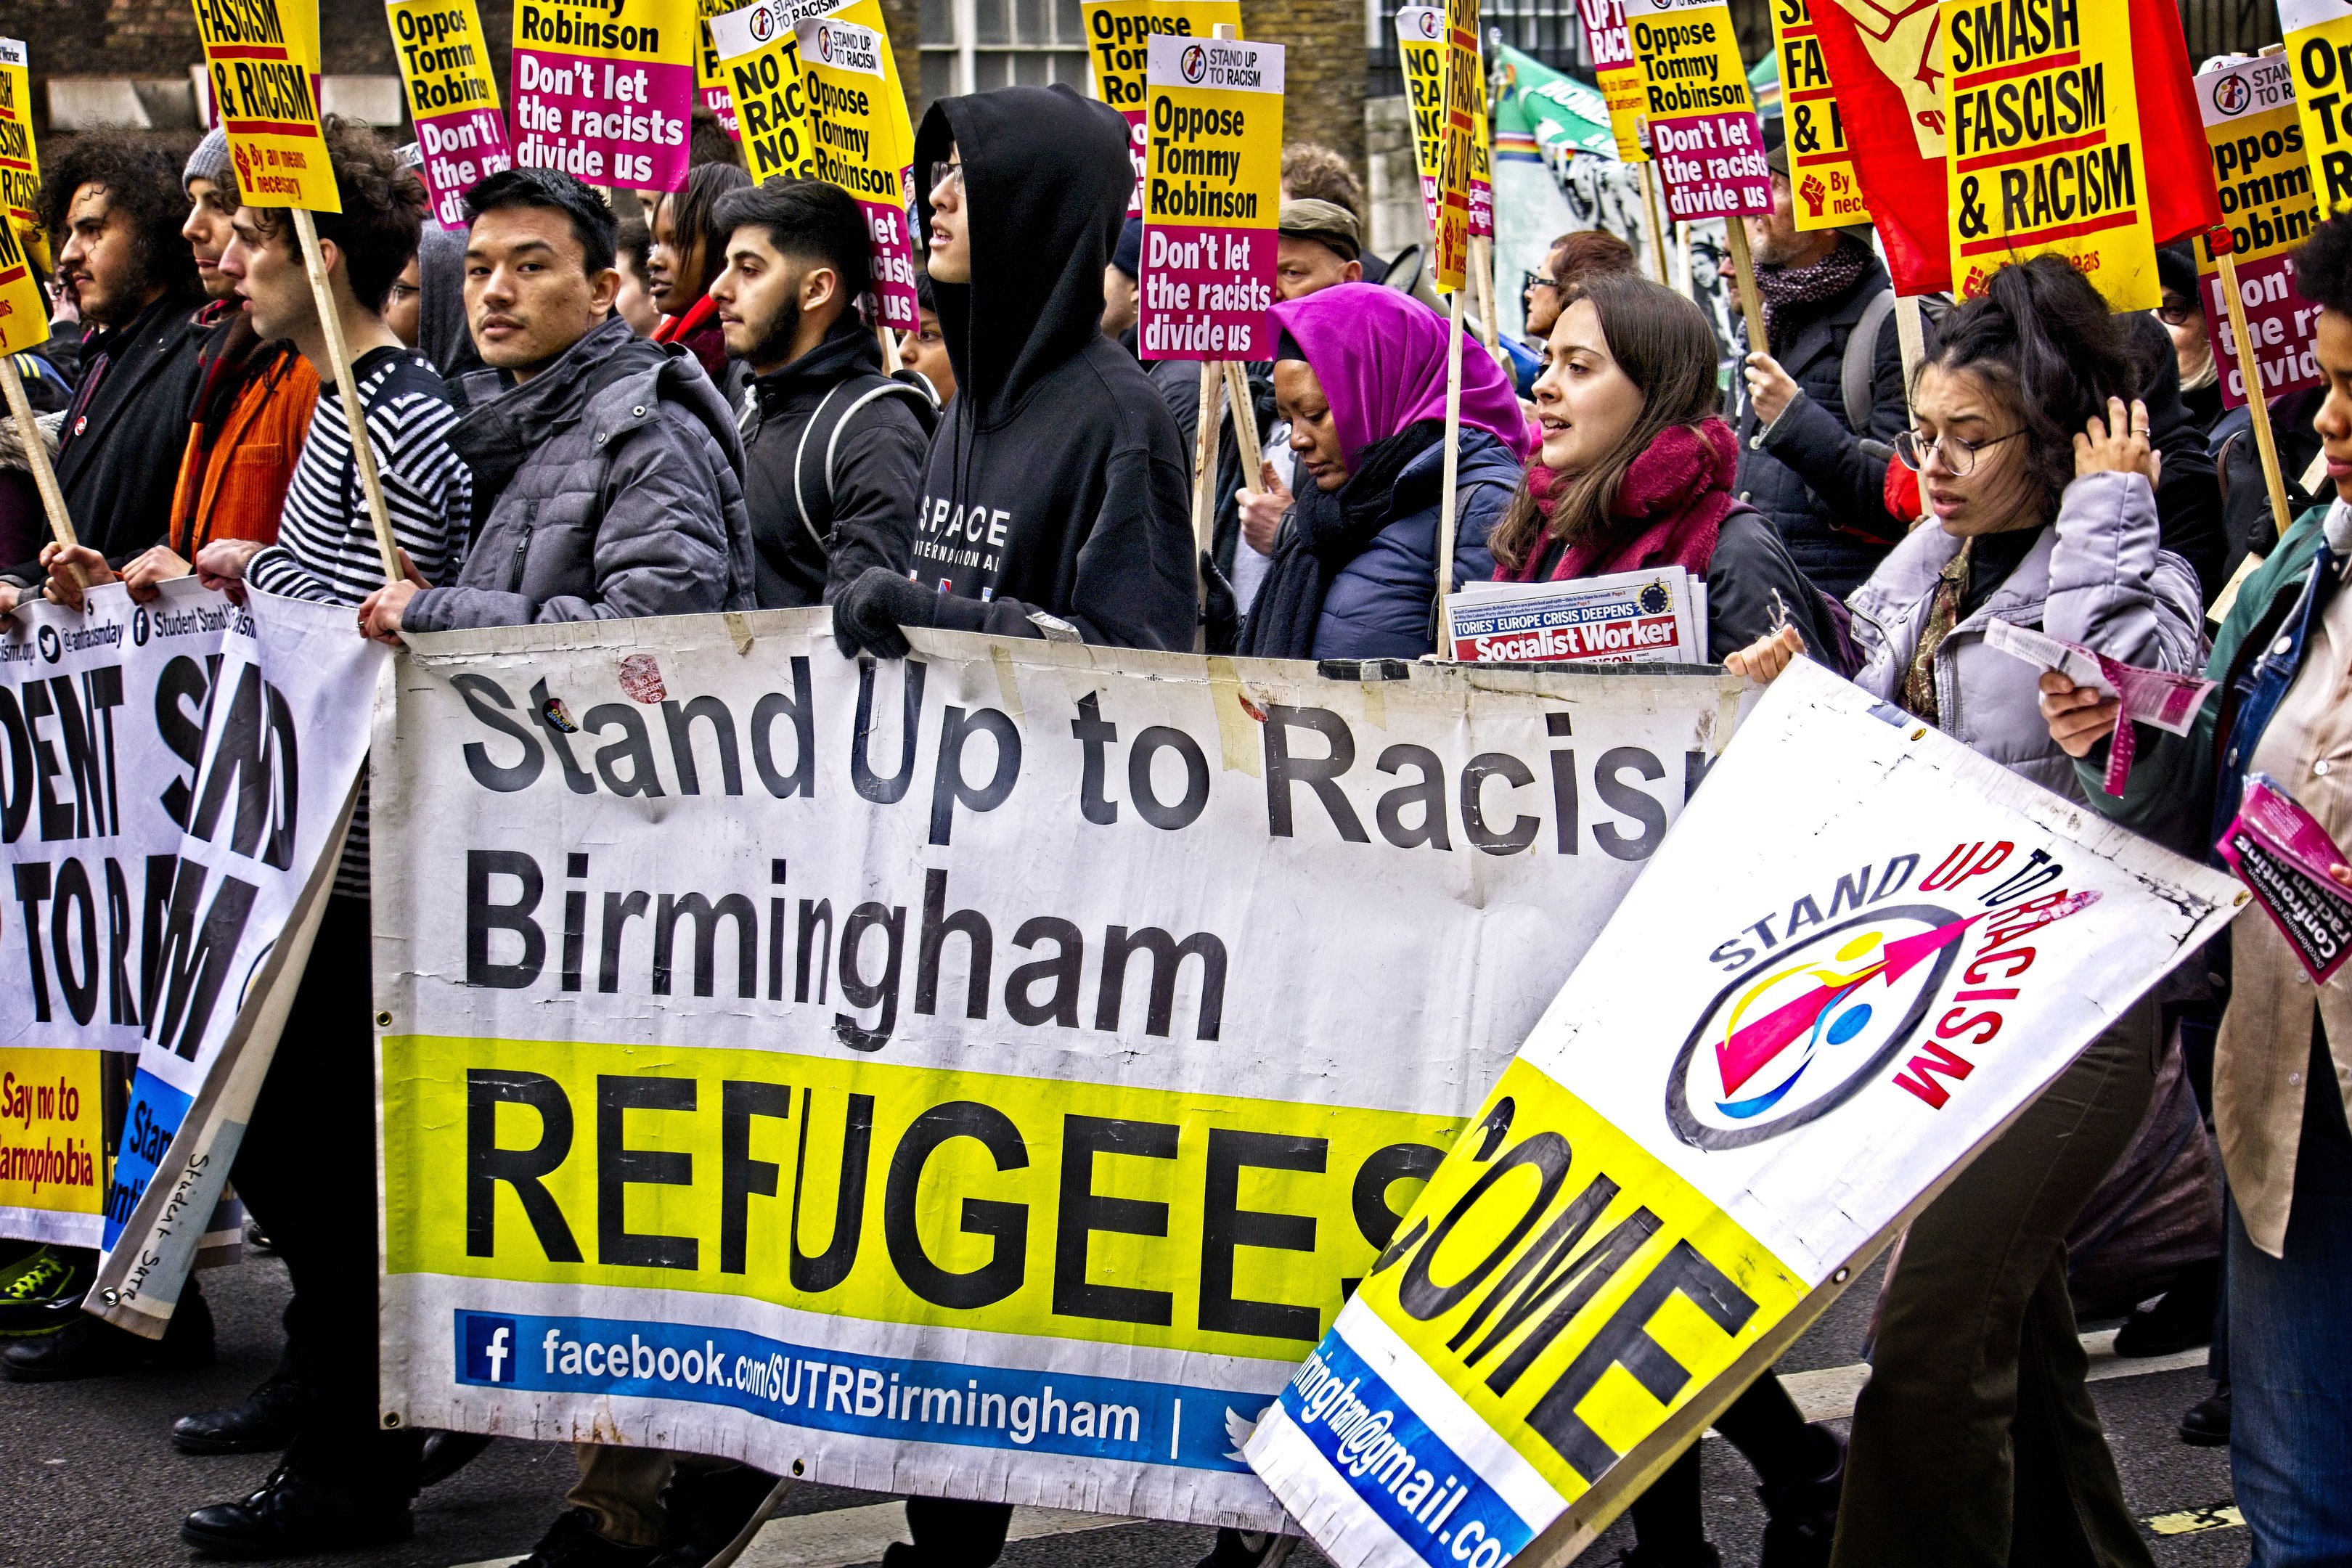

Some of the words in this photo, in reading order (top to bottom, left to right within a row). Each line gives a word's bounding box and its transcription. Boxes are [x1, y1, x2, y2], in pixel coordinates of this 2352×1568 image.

[396, 9, 467, 45] Oppos
[522, 6, 660, 54] Robinson
[791, 0, 840, 22] RACISM
[1093, 9, 1192, 44] Oppose
[402, 43, 476, 75] Tomm
[833, 30, 859, 50] STAND
[859, 35, 872, 52] UP
[834, 49, 846, 65] TO
[846, 51, 877, 70] RACISM
[1209, 48, 1243, 68] STAND
[1244, 51, 1257, 69] UP
[1635, 23, 1717, 56] Oppose
[1951, 0, 2081, 73] SMASH
[520, 54, 595, 99] Don't
[603, 64, 649, 104] let
[732, 53, 780, 100] NO
[1209, 68, 1225, 85] TO
[1226, 69, 1262, 88] RACISM
[1405, 48, 1440, 77] NO
[1639, 53, 1718, 83] Tommy
[215, 62, 238, 118] &
[234, 62, 315, 121] RACISM
[807, 70, 870, 117] Oppose
[1646, 83, 1745, 114] Robinson
[1954, 62, 2106, 157] FASCISM
[2255, 84, 2279, 107] TO
[518, 94, 563, 134] the
[571, 105, 685, 147] racists
[810, 109, 870, 163] Tommy
[1154, 95, 1244, 144] Oppose
[1654, 120, 1714, 154] Don't
[1719, 118, 1752, 147] let
[249, 143, 264, 171] By
[431, 156, 477, 190] the
[517, 133, 604, 177] divide
[613, 152, 654, 184] us
[814, 147, 896, 197] Robinson
[1153, 137, 1241, 186] Tommy
[1662, 155, 1704, 185] the
[1707, 148, 1769, 181] racists
[2208, 123, 2304, 182] ppos
[1151, 179, 1257, 219] Robinson
[1670, 183, 1739, 216] divide
[1743, 186, 1768, 209] us
[1830, 171, 1850, 195] By
[1958, 175, 1989, 239] &
[2000, 143, 2136, 232] RACISM
[1148, 231, 1218, 271] Don't
[1225, 234, 1251, 271] let
[883, 295, 912, 322] us
[1146, 272, 1191, 311] the
[1197, 274, 1270, 311] racists
[1145, 314, 1225, 351] divide
[1228, 323, 1251, 352] us
[919, 495, 1010, 547] SPACE
[154, 608, 199, 638] Student
[1455, 619, 1495, 636] TORIES'
[1498, 613, 1541, 632] EUROPE
[1543, 608, 1579, 626] CRISIS
[1581, 603, 1634, 621] DEEPENS
[1475, 627, 1580, 661] Socialist
[1580, 620, 1676, 653] Worker
[449, 656, 814, 799] Stand
[851, 656, 1022, 846] Up
[1071, 690, 1210, 830] to
[1918, 841, 2015, 892] UP
[1977, 848, 2064, 907] TO
[1709, 853, 1921, 972] STAND
[2234, 834, 2337, 959] Confronting
[2291, 872, 2352, 944] racism
[466, 849, 1228, 1053] Birmingham
[1892, 889, 2070, 1111] RACISM
[1, 1071, 32, 1130] Say
[37, 1080, 54, 1120] no
[58, 1076, 79, 1122] to
[158, 1153, 209, 1239] Student
[466, 1068, 1452, 1342] REFUGEES
[542, 1328, 1140, 1445] facebook.com/SUTRBirmingham
